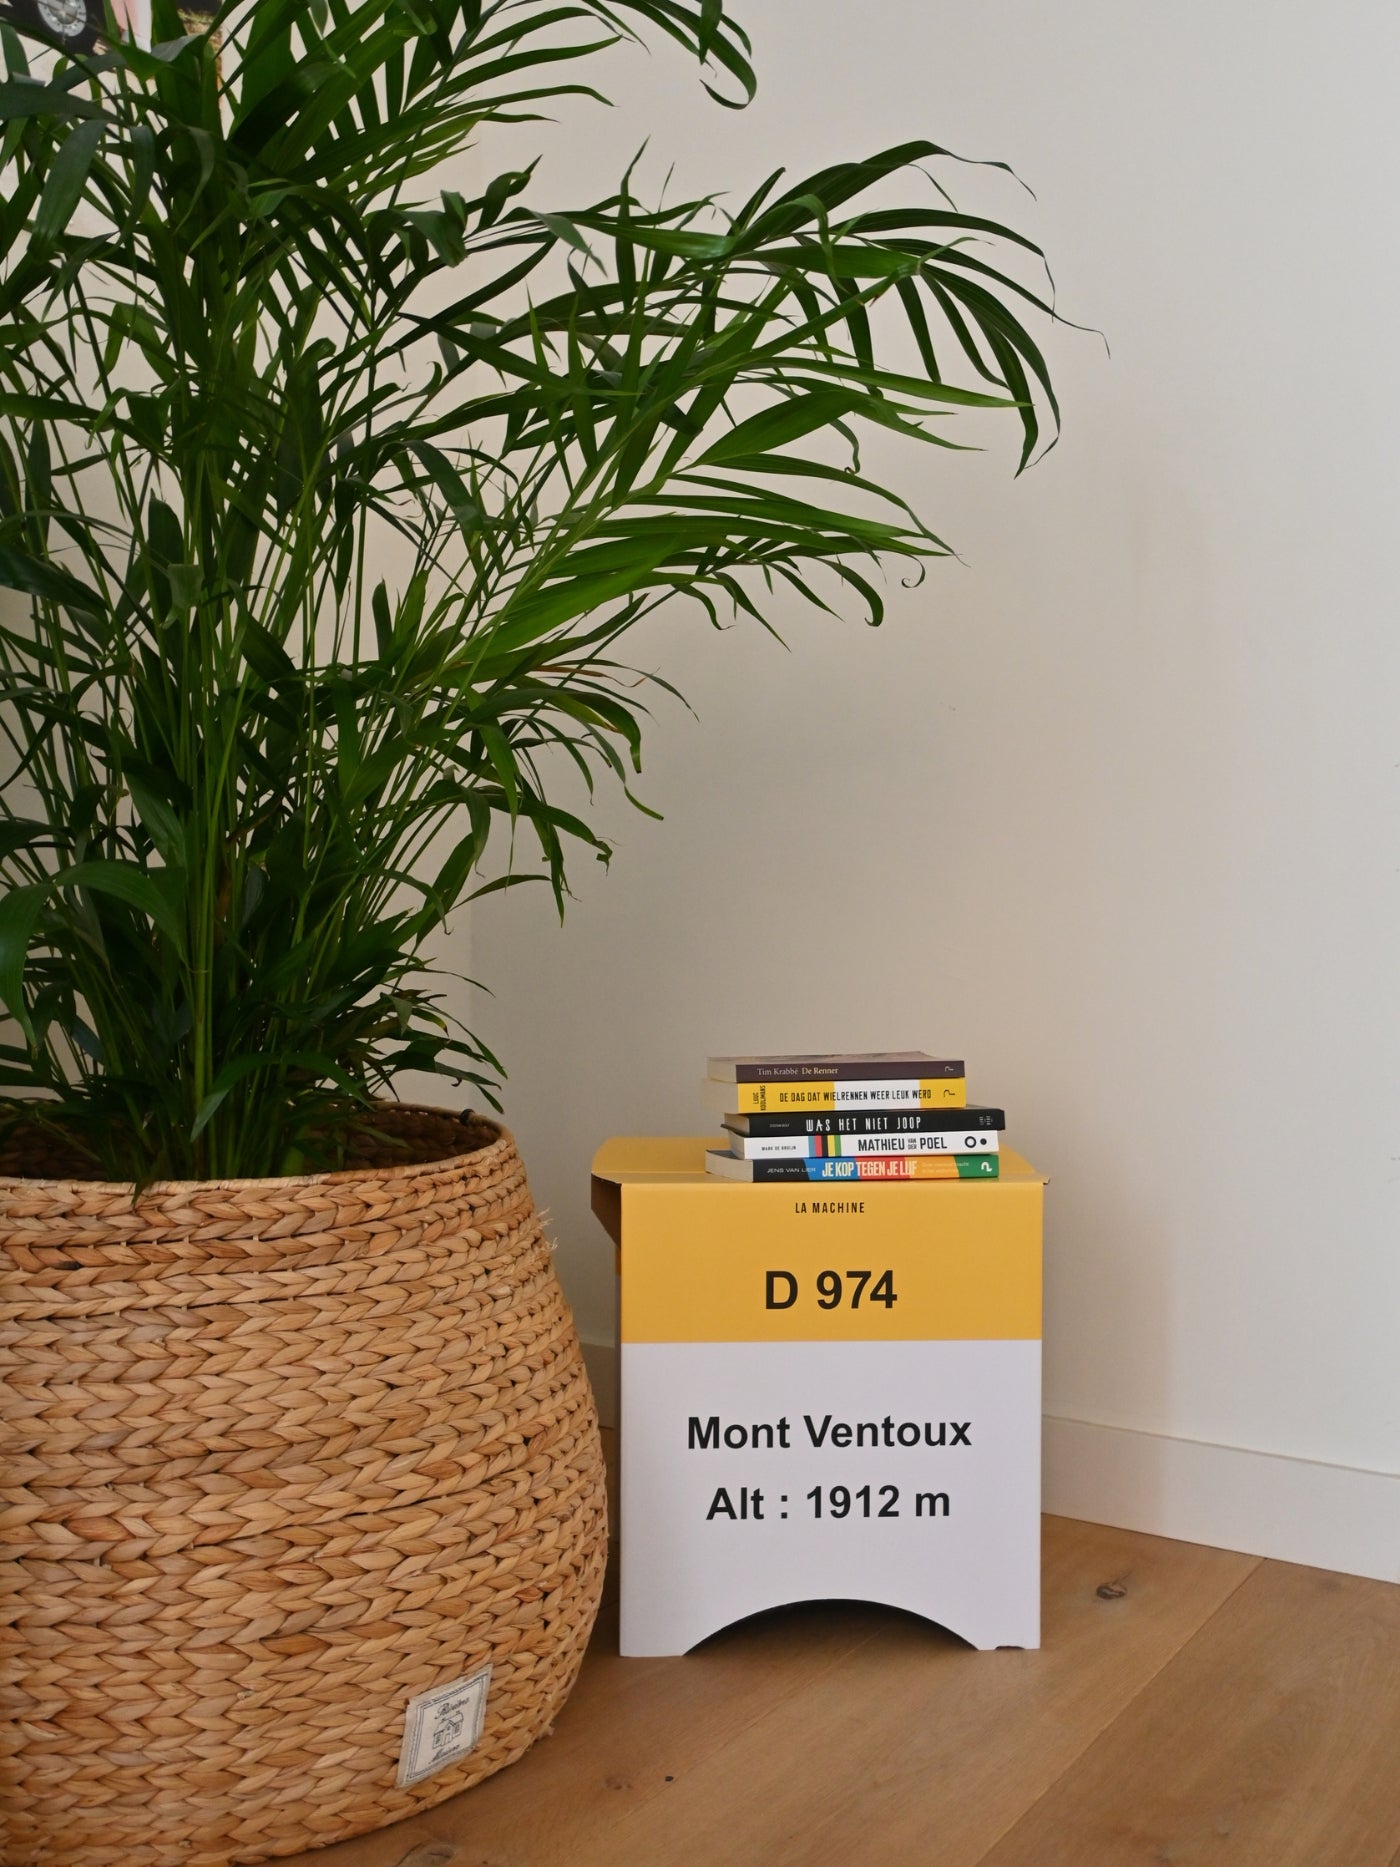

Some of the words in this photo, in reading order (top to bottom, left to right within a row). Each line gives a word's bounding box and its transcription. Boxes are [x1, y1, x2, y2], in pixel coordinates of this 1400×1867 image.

[757, 1068, 772, 1076] Tim
[773, 1067, 798, 1076] Krabbé
[801, 1067, 811, 1075] De
[813, 1066, 838, 1075] Renner
[780, 1092, 789, 1102] DE
[791, 1092, 805, 1102] DAG
[807, 1092, 820, 1102] DAT
[823, 1090, 868, 1101] WIELRENNEN
[870, 1090, 890, 1100] WEER
[891, 1089, 910, 1100] LEUK
[912, 1089, 931, 1099] WERD
[806, 1118, 831, 1132] WAS
[838, 1118, 857, 1131] HET
[865, 1117, 888, 1131] NIET
[896, 1116, 921, 1130] JOOP
[858, 1138, 905, 1152] MATHIEU
[920, 1136, 947, 1150] POEL
[822, 1162, 833, 1177] JE
[835, 1162, 854, 1177] KOP
[856, 1161, 885, 1177] TEGEN
[887, 1161, 899, 1176] JE
[795, 1202, 807, 1214] LA
[812, 1202, 865, 1214] MACHINE
[765, 1270, 798, 1310] D
[816, 1269, 898, 1310] 974
[688, 1416, 790, 1449] Mont
[803, 1415, 972, 1448] Ventoux
[706, 1487, 764, 1520] Alt
[806, 1485, 900, 1519] 1912
[914, 1491, 950, 1517] m
